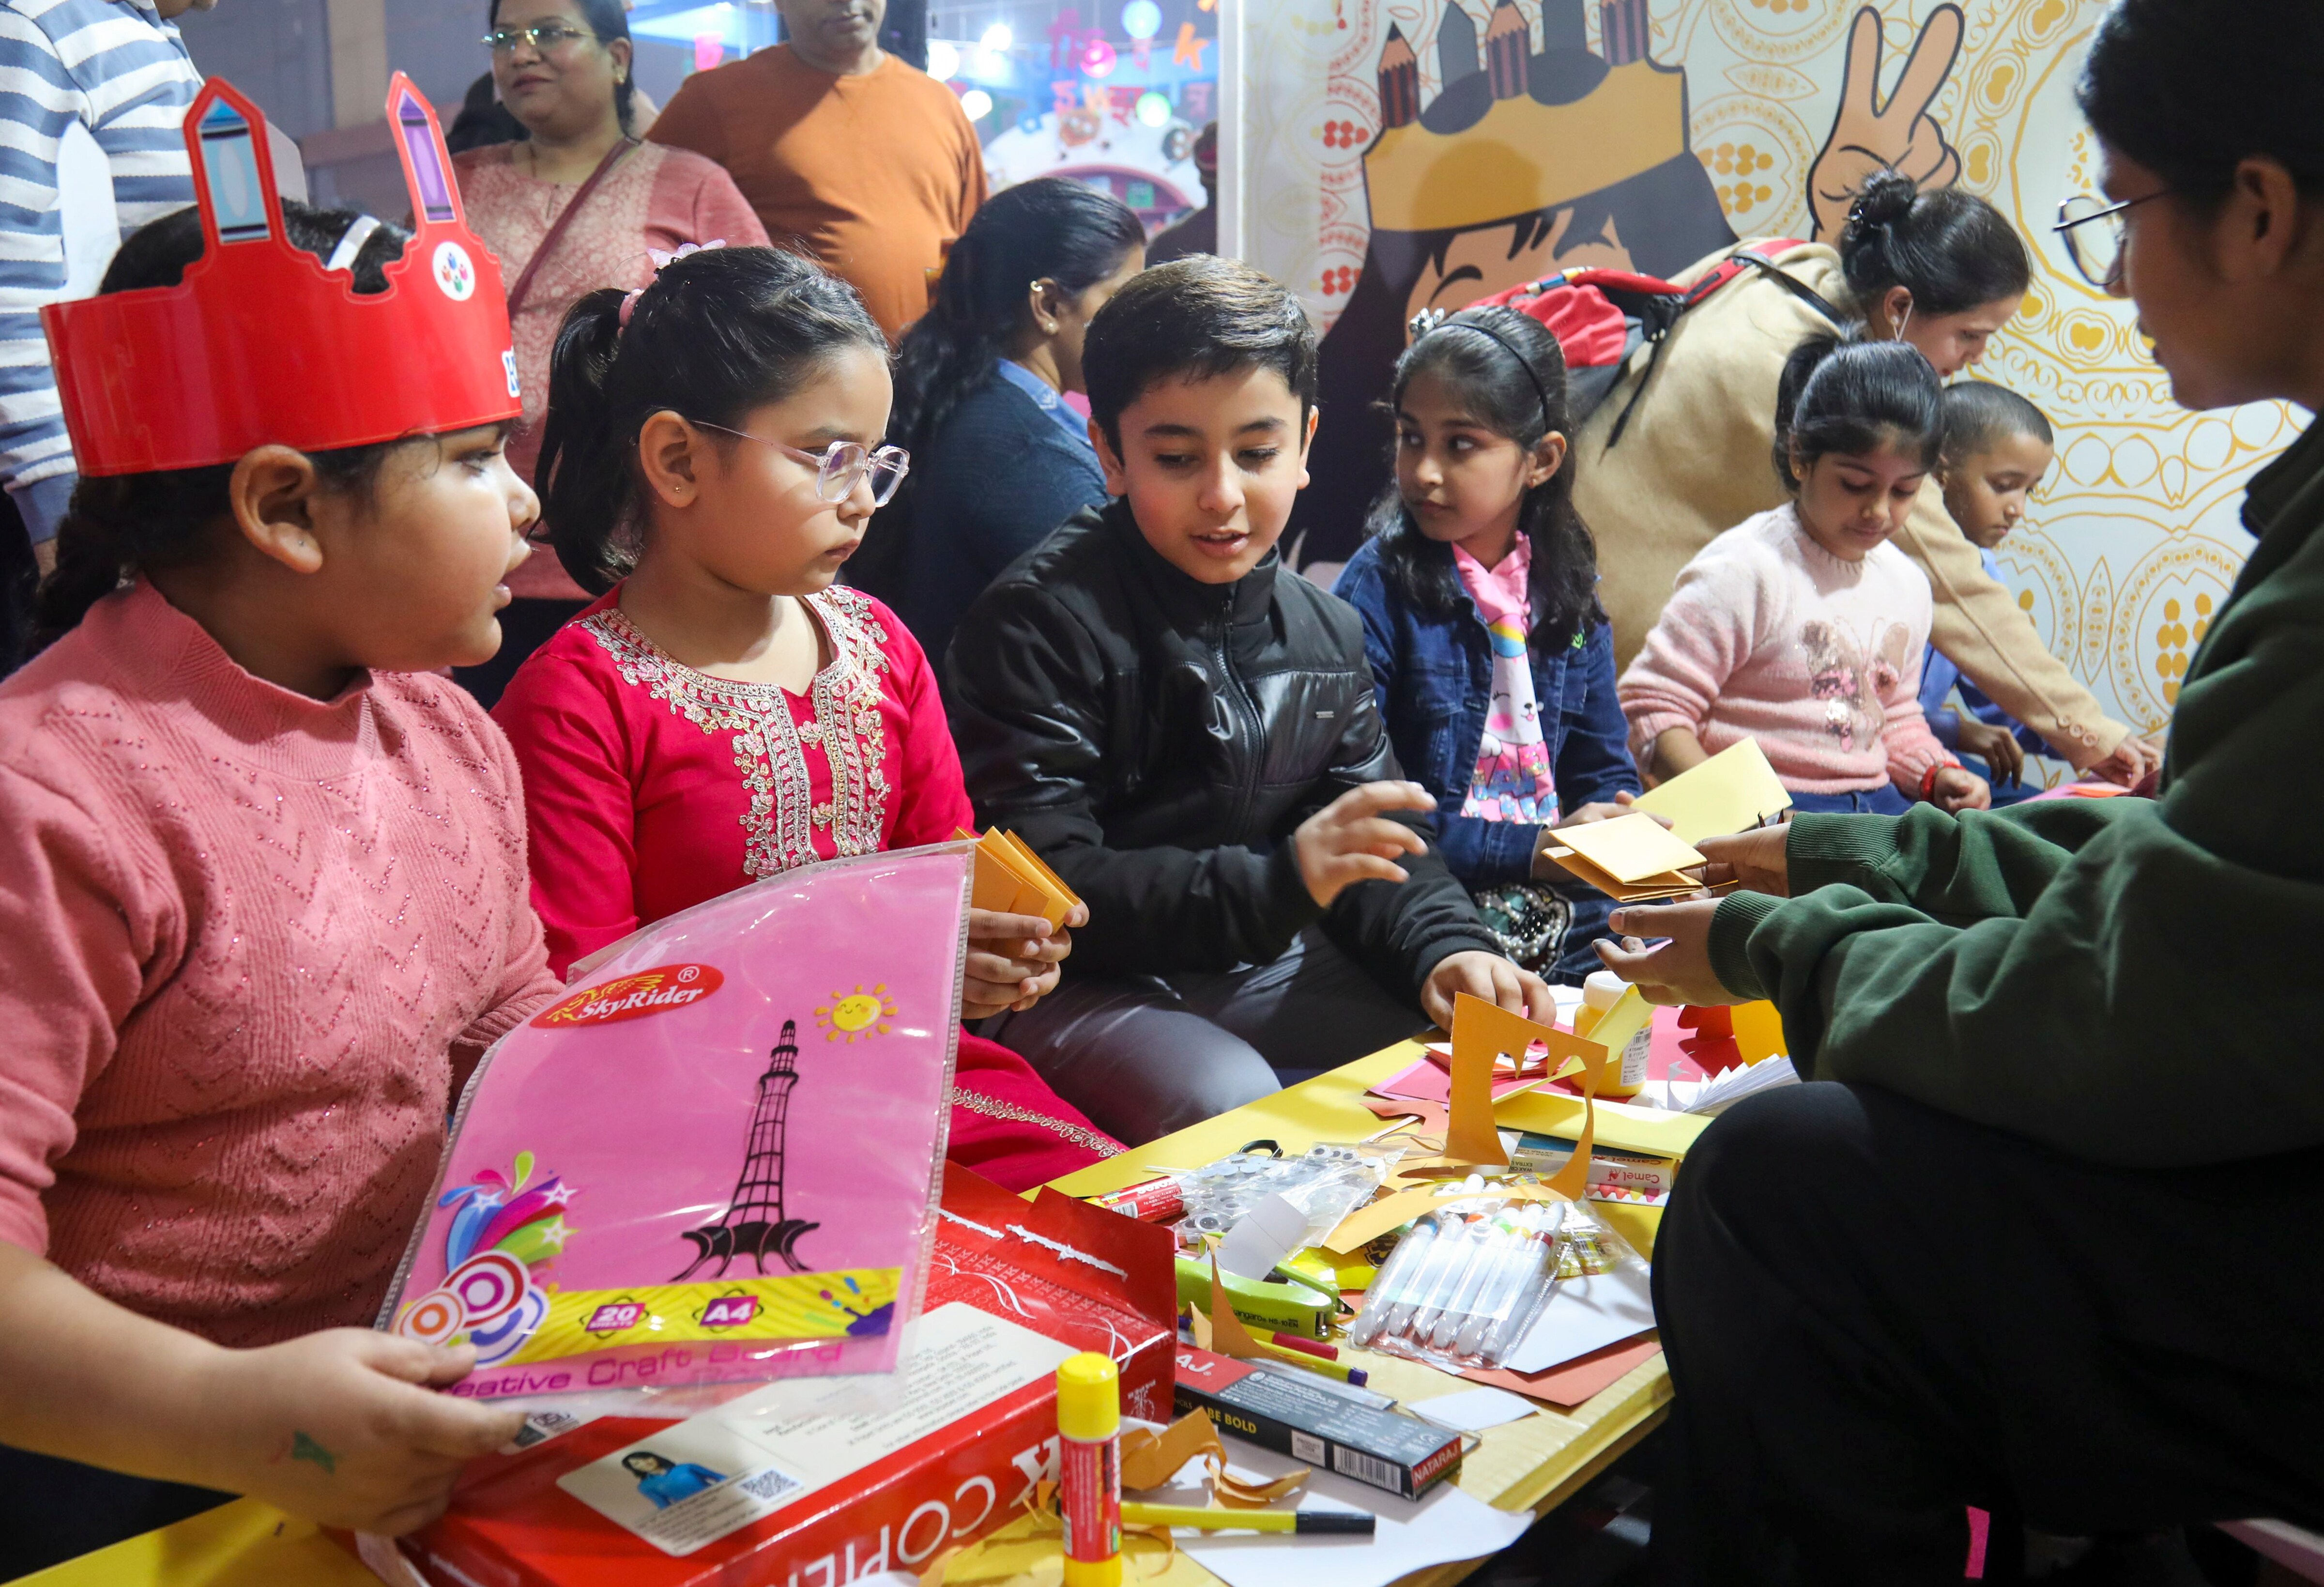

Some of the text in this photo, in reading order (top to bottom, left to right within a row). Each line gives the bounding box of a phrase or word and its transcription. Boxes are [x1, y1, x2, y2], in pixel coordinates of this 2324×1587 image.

[578, 985, 704, 1019] SkyRider
[1613, 1156, 1662, 1165] Camel
[1623, 1171, 1660, 1184] Camel
[597, 1306, 637, 1321] 20
[704, 1303, 752, 1322] A4
[452, 1372, 572, 1397] eative
[588, 1349, 692, 1387] Craft
[1208, 1407, 1257, 1434] BE BOLD
[1413, 1445, 1458, 1484] NATARAJ
[766, 1475, 997, 1587] COPIE
